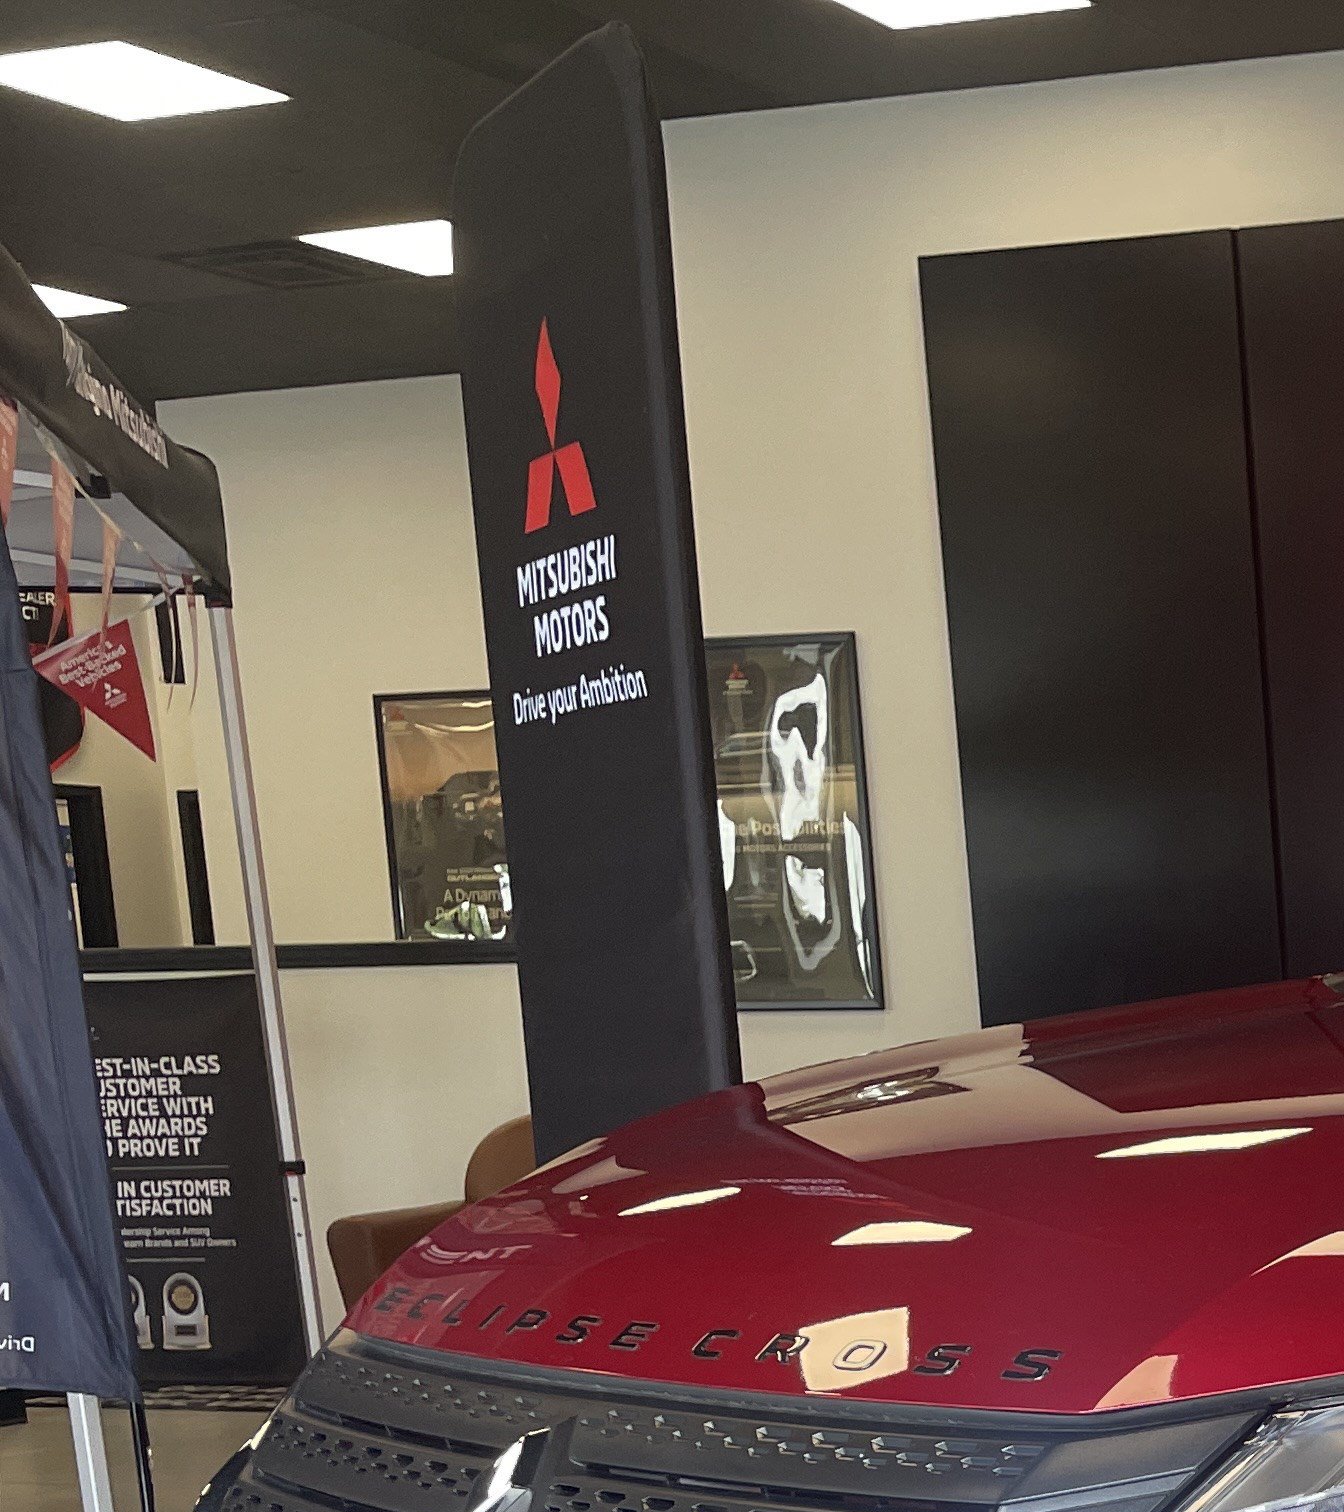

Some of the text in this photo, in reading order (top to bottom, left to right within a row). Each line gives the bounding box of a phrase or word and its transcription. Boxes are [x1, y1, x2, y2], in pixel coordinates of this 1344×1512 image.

[516, 534, 617, 608] MITSUBISHI
[533, 595, 610, 658] MOTORS
[512, 663, 648, 725] Drive your Ambition
[163, 1096, 215, 1116] WITH
[118, 1138, 180, 1158] PROVE
[185, 1137, 203, 1157] IT
[127, 1117, 208, 1137] AWARDS
[117, 1178, 231, 1198] IN CUSTOMER
[374, 1286, 1064, 1381] ECLIPSE CROSS
